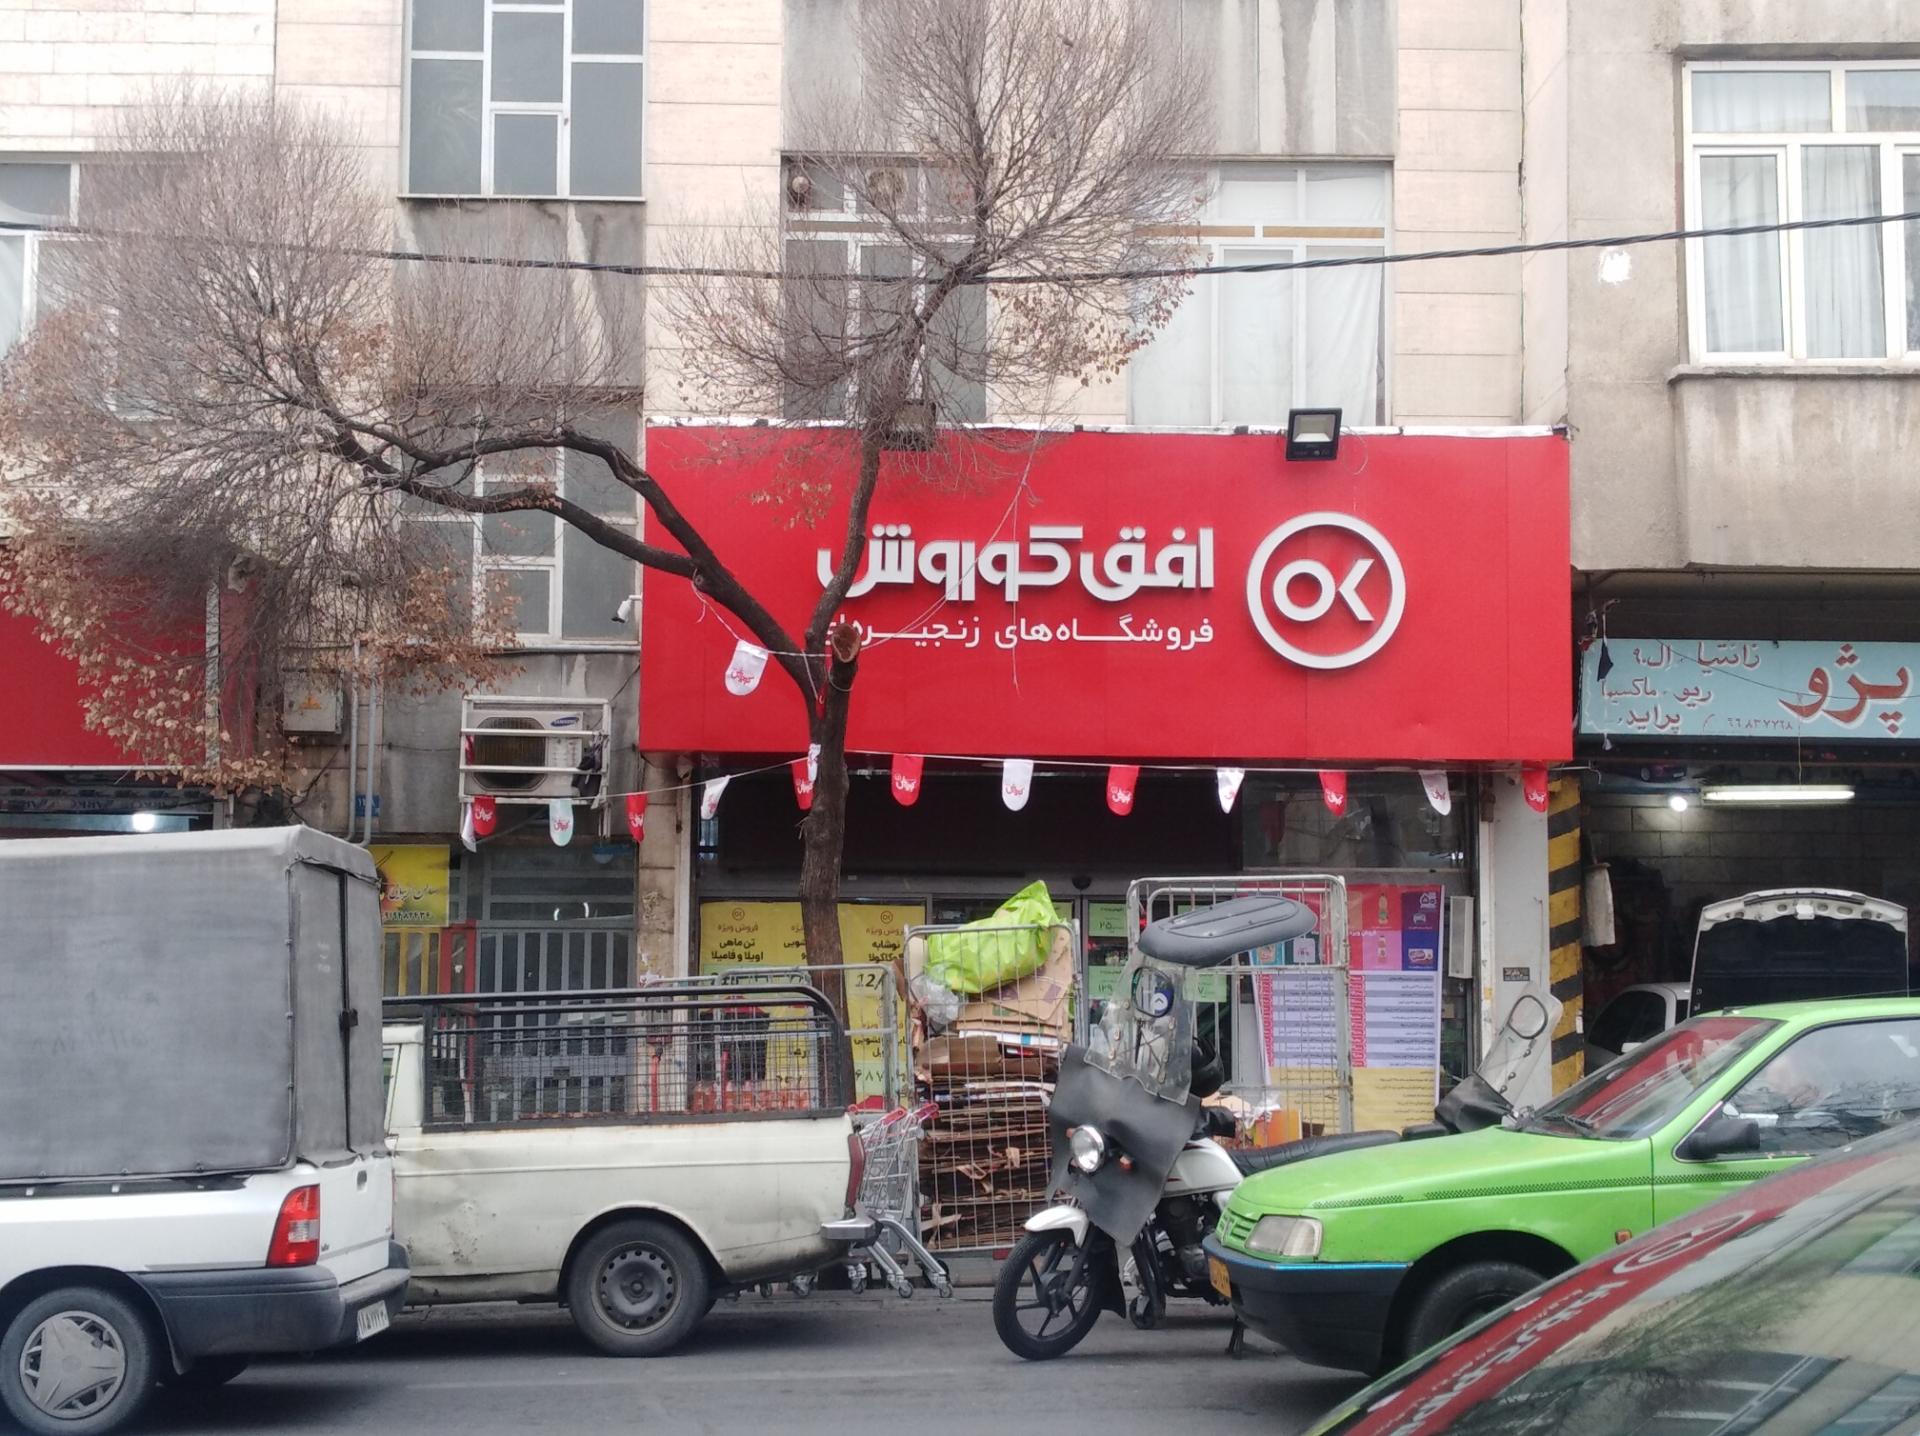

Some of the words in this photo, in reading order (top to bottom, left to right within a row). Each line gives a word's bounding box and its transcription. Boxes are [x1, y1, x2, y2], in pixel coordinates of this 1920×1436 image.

[817, 523, 1085, 603] کوروش
[1080, 525, 1214, 602] افق
[1273, 557, 1375, 622] OK
[1778, 642, 1911, 735] پژو
